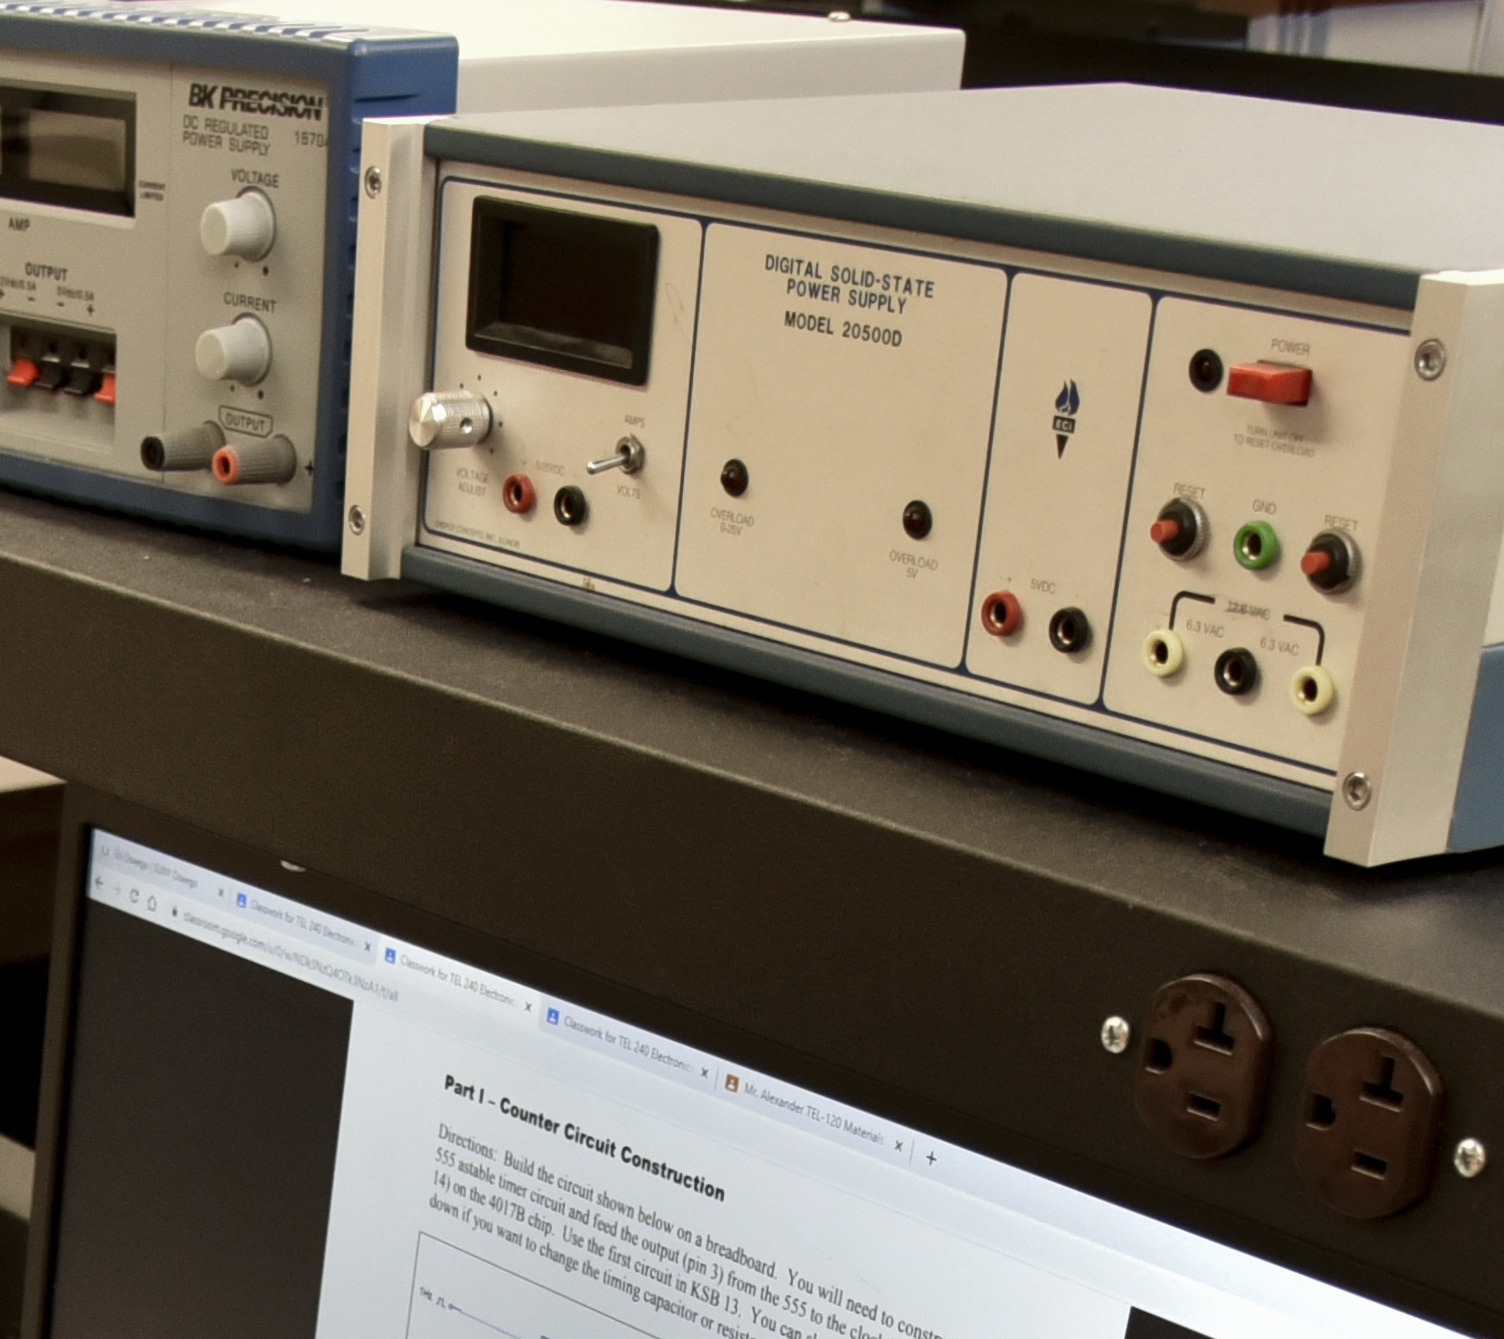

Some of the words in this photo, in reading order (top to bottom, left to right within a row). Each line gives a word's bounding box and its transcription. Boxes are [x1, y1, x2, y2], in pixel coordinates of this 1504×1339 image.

[189, 83, 218, 109] BK
[219, 86, 324, 121] PRECISION
[183, 114, 198, 130] DC
[204, 117, 269, 140] REGULATED
[182, 130, 222, 149] POWER
[229, 137, 270, 156] SUPPLY
[231, 168, 280, 188] VOLTAGE
[8, 217, 30, 231] AMP
[25, 262, 68, 282] OUTPUT
[765, 254, 823, 279] DIGITAL
[830, 265, 935, 298] SOLID-STATE
[223, 291, 276, 313] CURRENT
[787, 278, 841, 303] POWER
[848, 289, 907, 314] SUPPLY
[784, 311, 834, 335] MODEL
[842, 321, 903, 347] 20500D
[1271, 338, 1310, 356] POWER
[226, 412, 265, 431] OUTPUT
[624, 415, 646, 428] AMPS
[456, 468, 490, 484] VOLTAGE
[458, 482, 487, 497] ADJUST
[617, 484, 641, 499] VOLTS
[1174, 483, 1205, 499] RESET
[710, 507, 755, 527] OVERLOAD
[1252, 500, 1276, 515] GND
[1324, 514, 1358, 532] RESET
[889, 550, 938, 571] OVERLOAD
[1186, 619, 1200, 633] 6.3
[1203, 624, 1225, 638] VAC
[1260, 637, 1275, 650] 6.3
[1278, 642, 1300, 657] VAC
[760, 1087, 805, 1115] Alexander
[807, 1105, 842, 1127] TEL-120
[444, 1074, 474, 1100] Part
[478, 1088, 484, 1104] I
[499, 1097, 560, 1134] Counter
[564, 1122, 616, 1157] Circuit
[620, 1145, 724, 1201] Construction
[434, 1146, 456, 1167] 555
[457, 1160, 496, 1185] astable
[498, 1174, 528, 1198] timer
[529, 1188, 566, 1215] circuit
[567, 1207, 590, 1225] and
[592, 1212, 618, 1237] feed
[620, 1225, 638, 1246] the
[641, 1238, 679, 1264] output
[682, 1252, 707, 1275] (pin
[709, 1262, 724, 1285] 3)
[726, 1270, 756, 1296] from
[760, 1284, 779, 1306] the
[782, 1294, 807, 1317] 555
[809, 1307, 823, 1325] to
[826, 1313, 846, 1335] the
[503, 1149, 535, 1176] Build
[536, 1165, 554, 1185] the
[556, 1175, 593, 1202] circuit
[596, 1190, 634, 1219] shown
[637, 1205, 674, 1234] below
[676, 1227, 692, 1243] on
[694, 1234, 702, 1247] a
[705, 1234, 776, 1279] breadboard.
[788, 1267, 813, 1294] You
[817, 1285, 843, 1307] will
[845, 1298, 878, 1321] need
[880, 1310, 894, 1328] to
[433, 1169, 450, 1192] 14)
[452, 1182, 466, 1197] on
[469, 1186, 486, 1205] the
[488, 1194, 525, 1222] 4017B
[527, 1212, 554, 1237] chip.
[562, 1224, 584, 1248] Use
[587, 1236, 605, 1257] the
[607, 1244, 631, 1269] first
[633, 1258, 672, 1287] circuit
[675, 1273, 687, 1293] in
[690, 1280, 720, 1306] KSB
[724, 1295, 740, 1317] 13.
[751, 1305, 776, 1332] You
[429, 1192, 459, 1218] down
[461, 1205, 473, 1223] if
[471, 1214, 493, 1233] you
[496, 1225, 523, 1246] want
[525, 1236, 537, 1252] to
[538, 1242, 579, 1272] change
[581, 1259, 600, 1280] the
[602, 1269, 640, 1302] timing
[643, 1290, 698, 1323] capacitor
[700, 1316, 714, 1330] or
